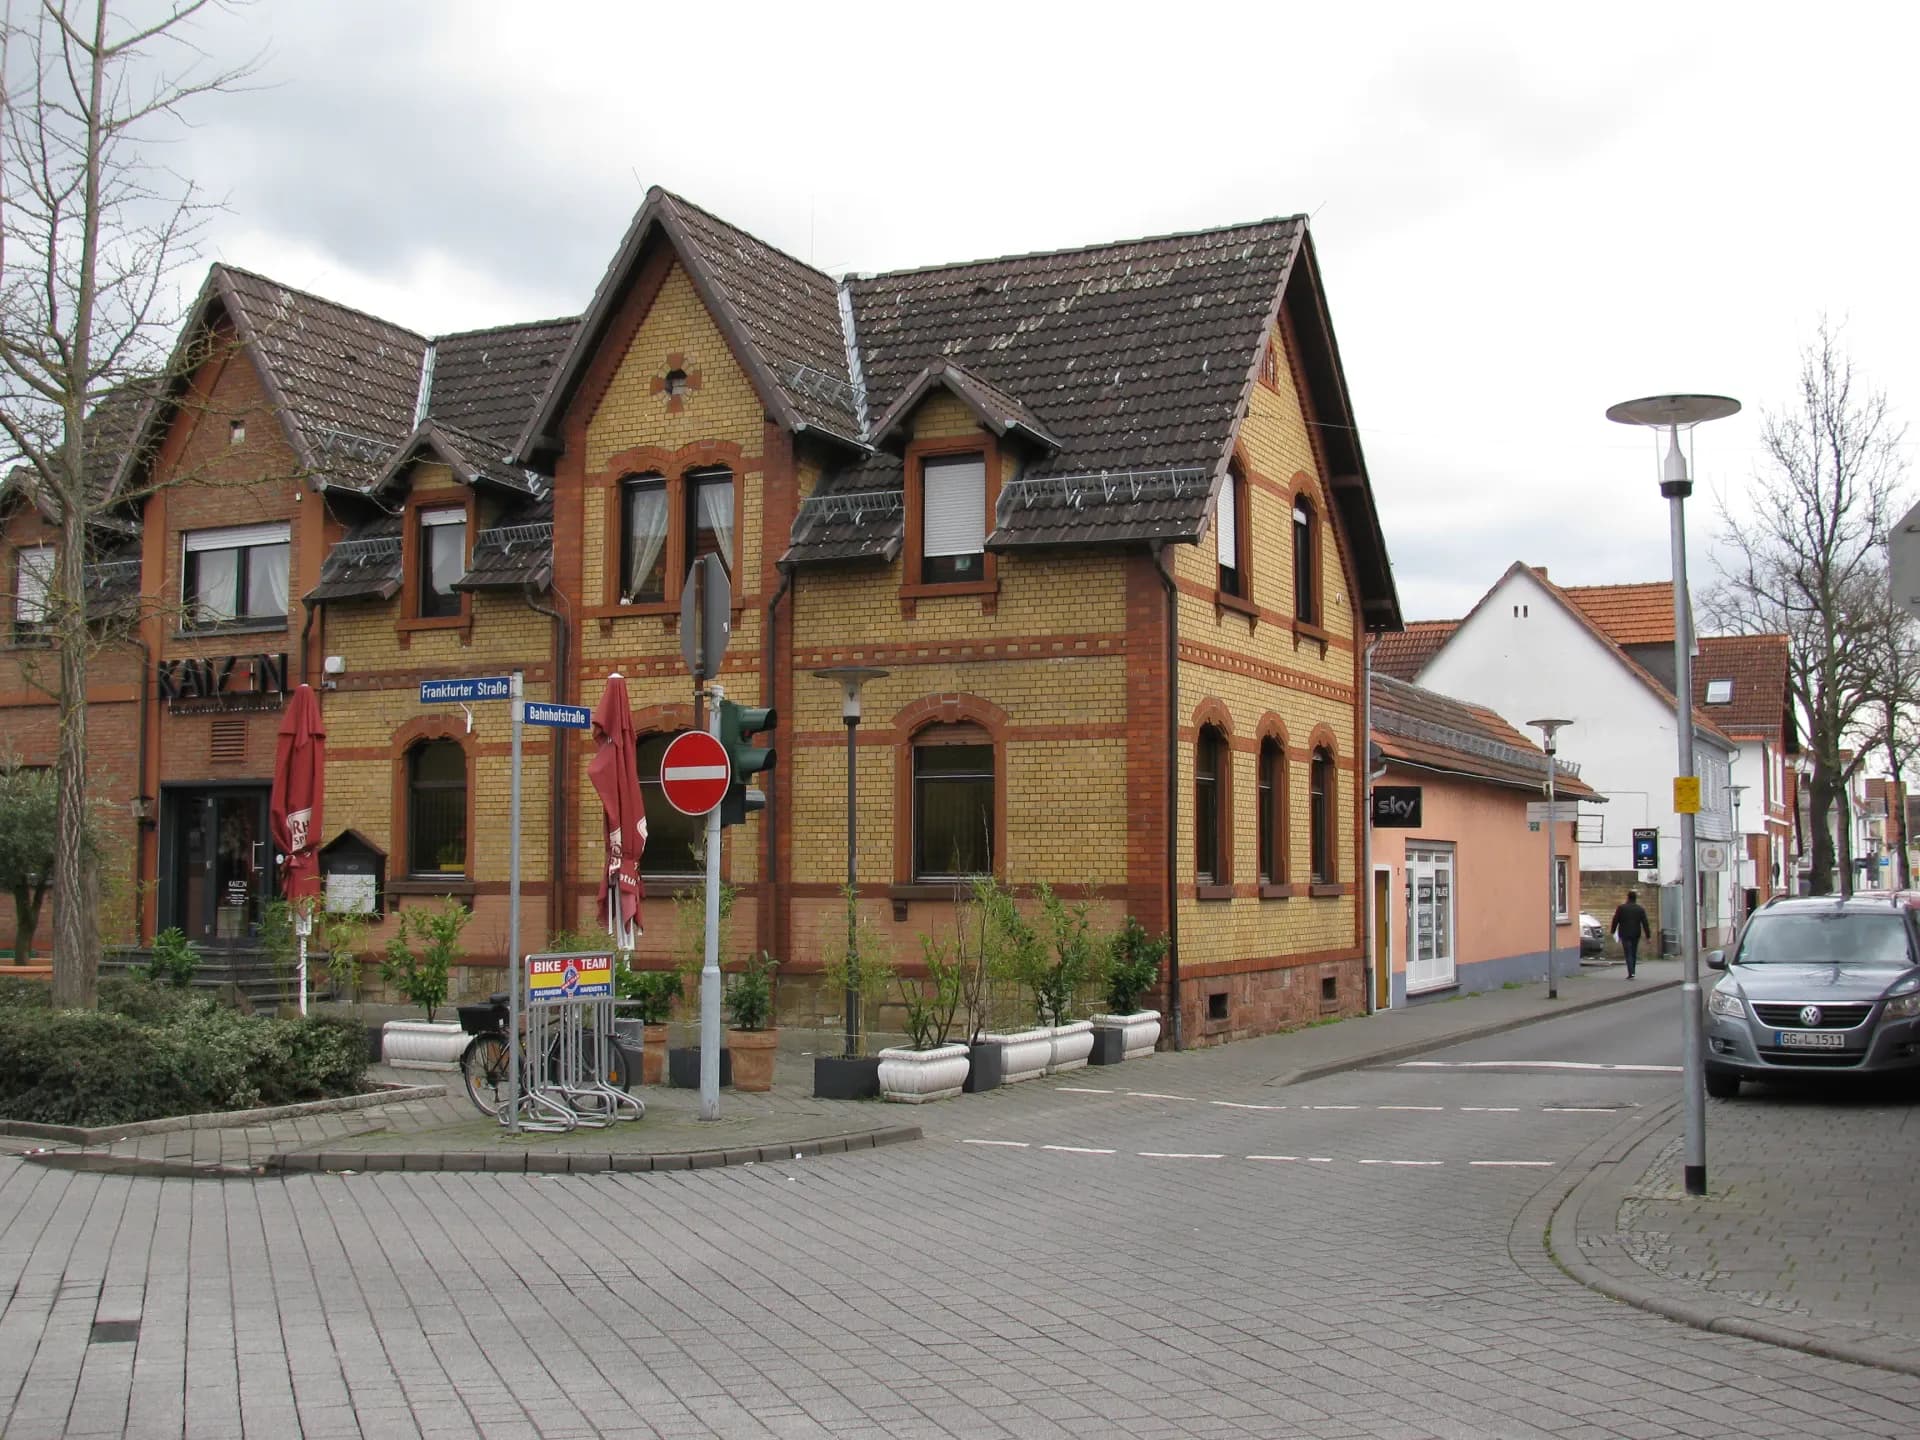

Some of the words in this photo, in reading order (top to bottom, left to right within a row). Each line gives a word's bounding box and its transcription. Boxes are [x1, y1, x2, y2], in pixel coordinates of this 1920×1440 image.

[422, 683, 473, 698] Frankfurter
[477, 681, 508, 696] Straße
[529, 706, 585, 724] Bahnhofstraße
[1378, 795, 1416, 819] sky
[534, 960, 561, 973] BIKE
[581, 957, 607, 970] TEAM
[1783, 1033, 1797, 1044] GG
[1815, 1034, 1843, 1046] 1511
